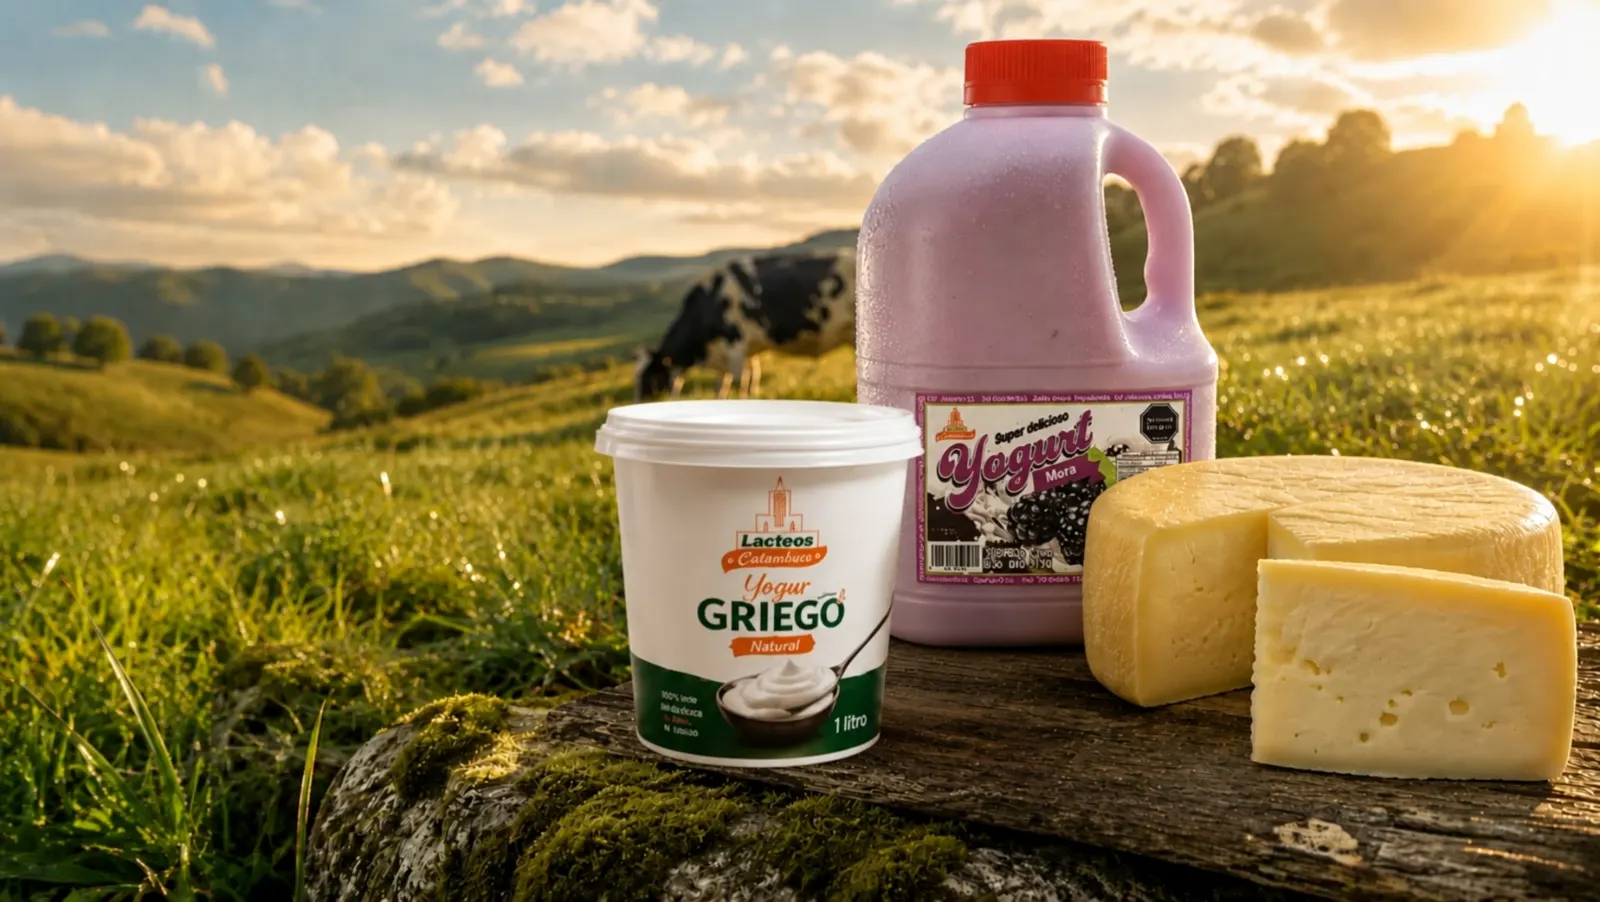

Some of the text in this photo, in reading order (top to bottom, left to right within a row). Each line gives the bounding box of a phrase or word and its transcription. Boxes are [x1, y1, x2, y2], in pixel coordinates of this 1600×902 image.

[994, 412, 1069, 445] Super delicioso
[937, 409, 1094, 513] Yogurt
[1045, 464, 1077, 482] Mora
[741, 534, 814, 548] Lacteos
[742, 573, 811, 603] Yogur
[697, 597, 845, 632] GRIEGO
[750, 639, 800, 652] Natural
[834, 714, 867, 733] 1 litro
